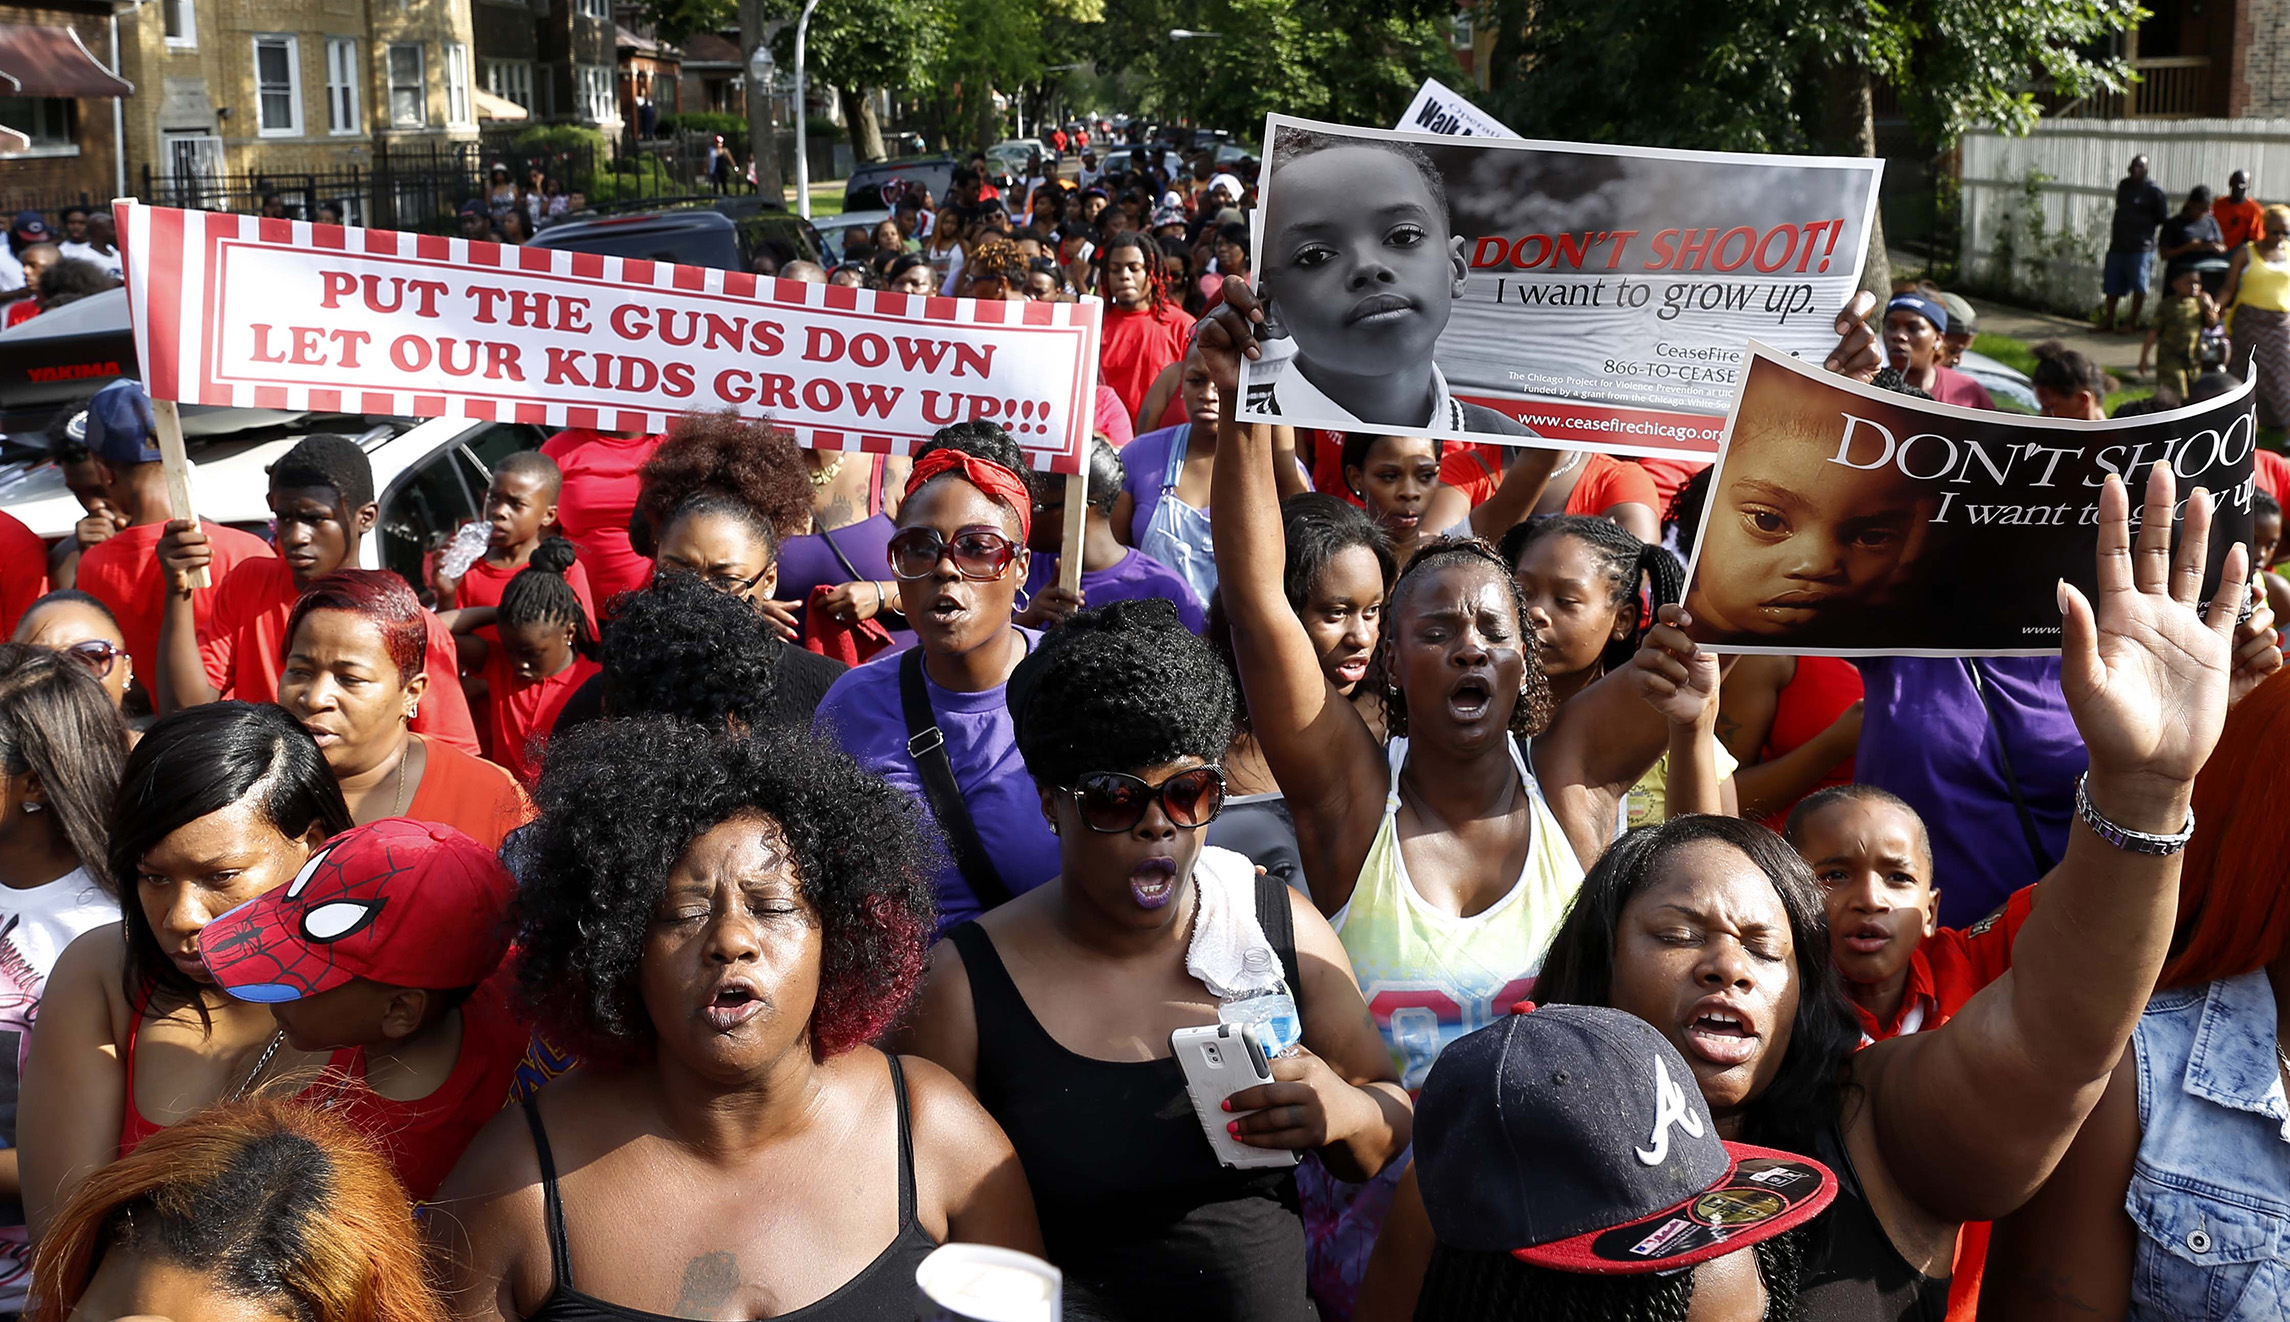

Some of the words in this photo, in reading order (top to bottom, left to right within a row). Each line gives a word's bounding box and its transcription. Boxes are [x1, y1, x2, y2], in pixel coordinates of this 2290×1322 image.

[1471, 231, 1638, 269] DON'T
[1644, 218, 1844, 273] SHOOT!
[1496, 278, 1506, 304] I
[1518, 278, 1605, 307] want
[1616, 278, 1650, 308] to
[1656, 282, 1759, 321] grow
[1764, 283, 1816, 325] up.
[319, 270, 449, 318] PUT
[466, 285, 592, 334] THE
[610, 304, 784, 357] GUNS
[802, 326, 997, 379] DOWN
[26, 361, 122, 382] YAKIMA
[1603, 359, 1736, 384] 866-TO-CEASE
[1656, 342, 1740, 363] CeaseFire
[250, 323, 372, 369] LET
[390, 334, 525, 382] OUR
[545, 347, 696, 398] KIDS
[714, 369, 904, 419] GROW
[921, 390, 1051, 435] UP!!!
[1508, 371, 1525, 381] The
[1527, 372, 1564, 385] Chicago
[1566, 376, 1598, 387] Project
[1600, 378, 1613, 388] for
[1615, 380, 1654, 392] Violence
[1656, 383, 1704, 396] Prevention
[1706, 388, 1716, 396] at
[1718, 389, 1735, 398] UIC
[1523, 384, 1557, 395] Funded
[1559, 387, 1571, 398] by
[1581, 390, 1605, 399] grant
[1607, 391, 1629, 401] from
[1631, 393, 1646, 402] the
[1648, 394, 1685, 407] Chicago
[1687, 397, 1714, 407] White
[1827, 411, 2085, 487] DON'T
[1928, 491, 1960, 523] I
[1965, 501, 2072, 526] want
[1634, 1053, 1705, 1166] A
